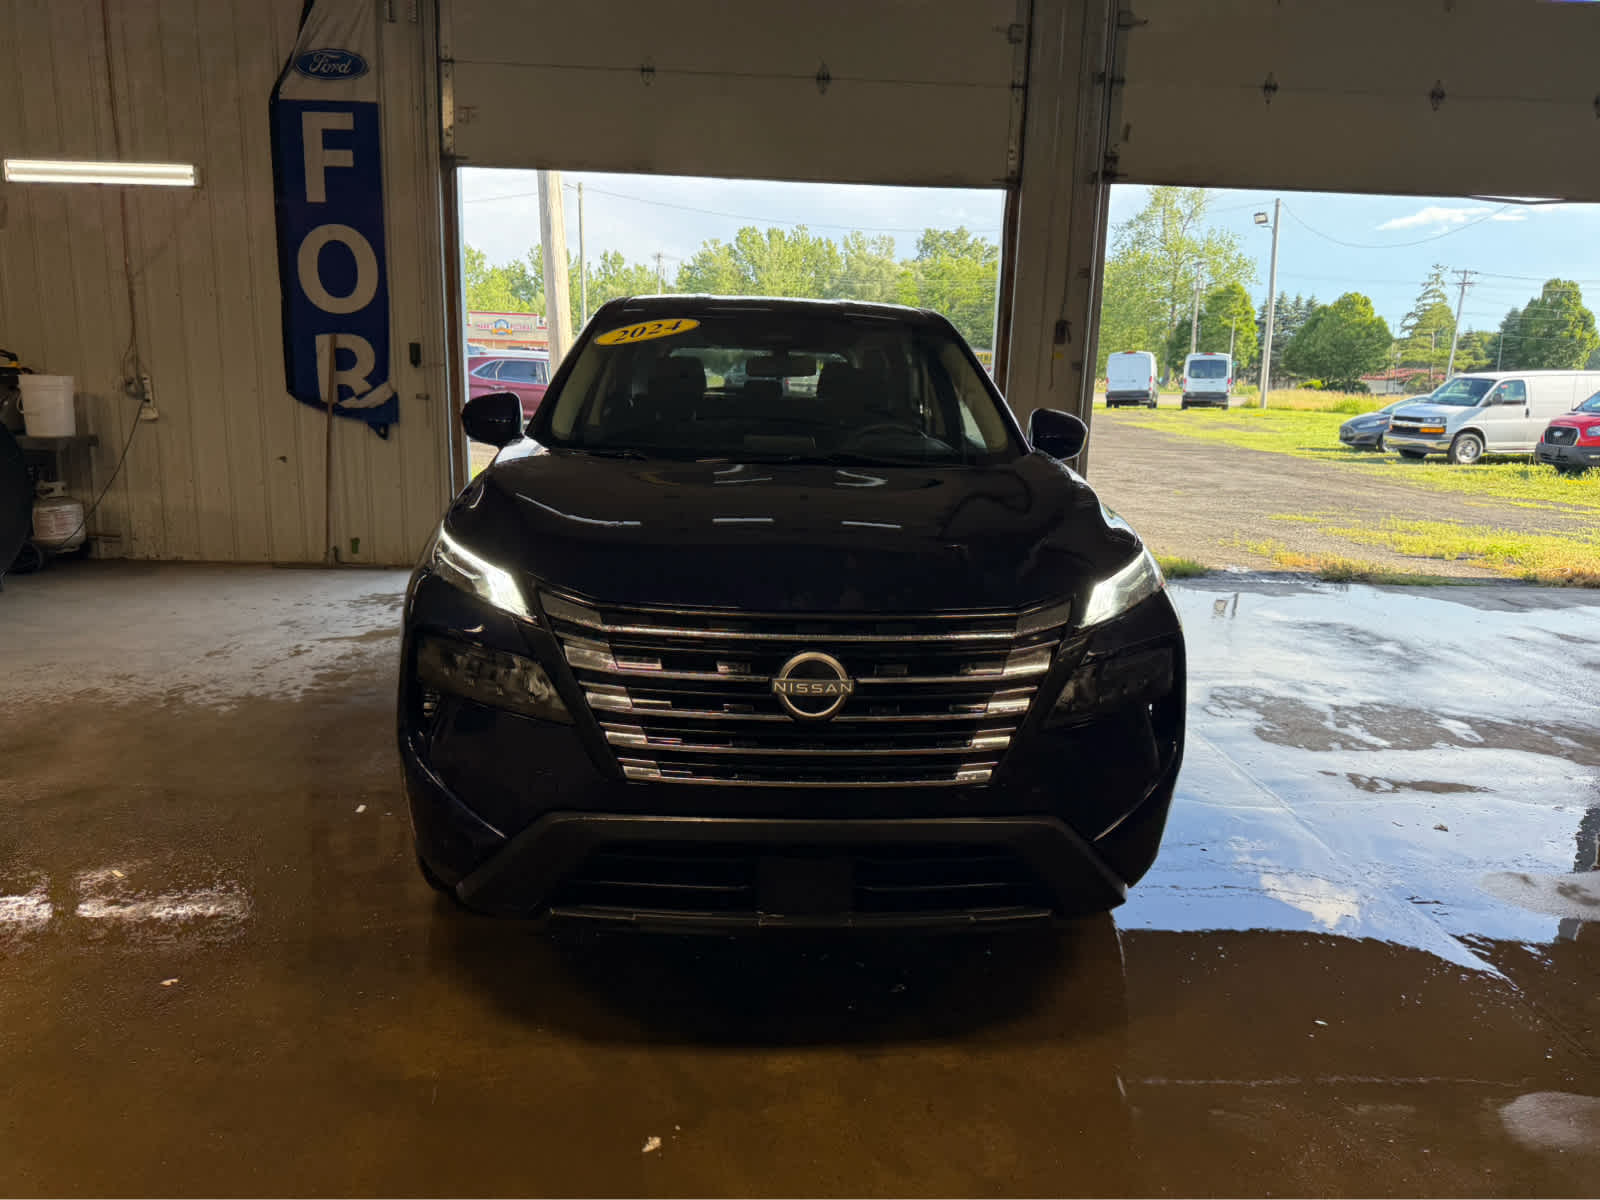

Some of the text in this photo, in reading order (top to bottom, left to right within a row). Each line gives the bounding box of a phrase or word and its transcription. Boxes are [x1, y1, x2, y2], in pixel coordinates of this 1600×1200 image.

[309, 54, 352, 74] Ford
[614, 320, 683, 342] 2024
[774, 682, 853, 694] NISSAN
